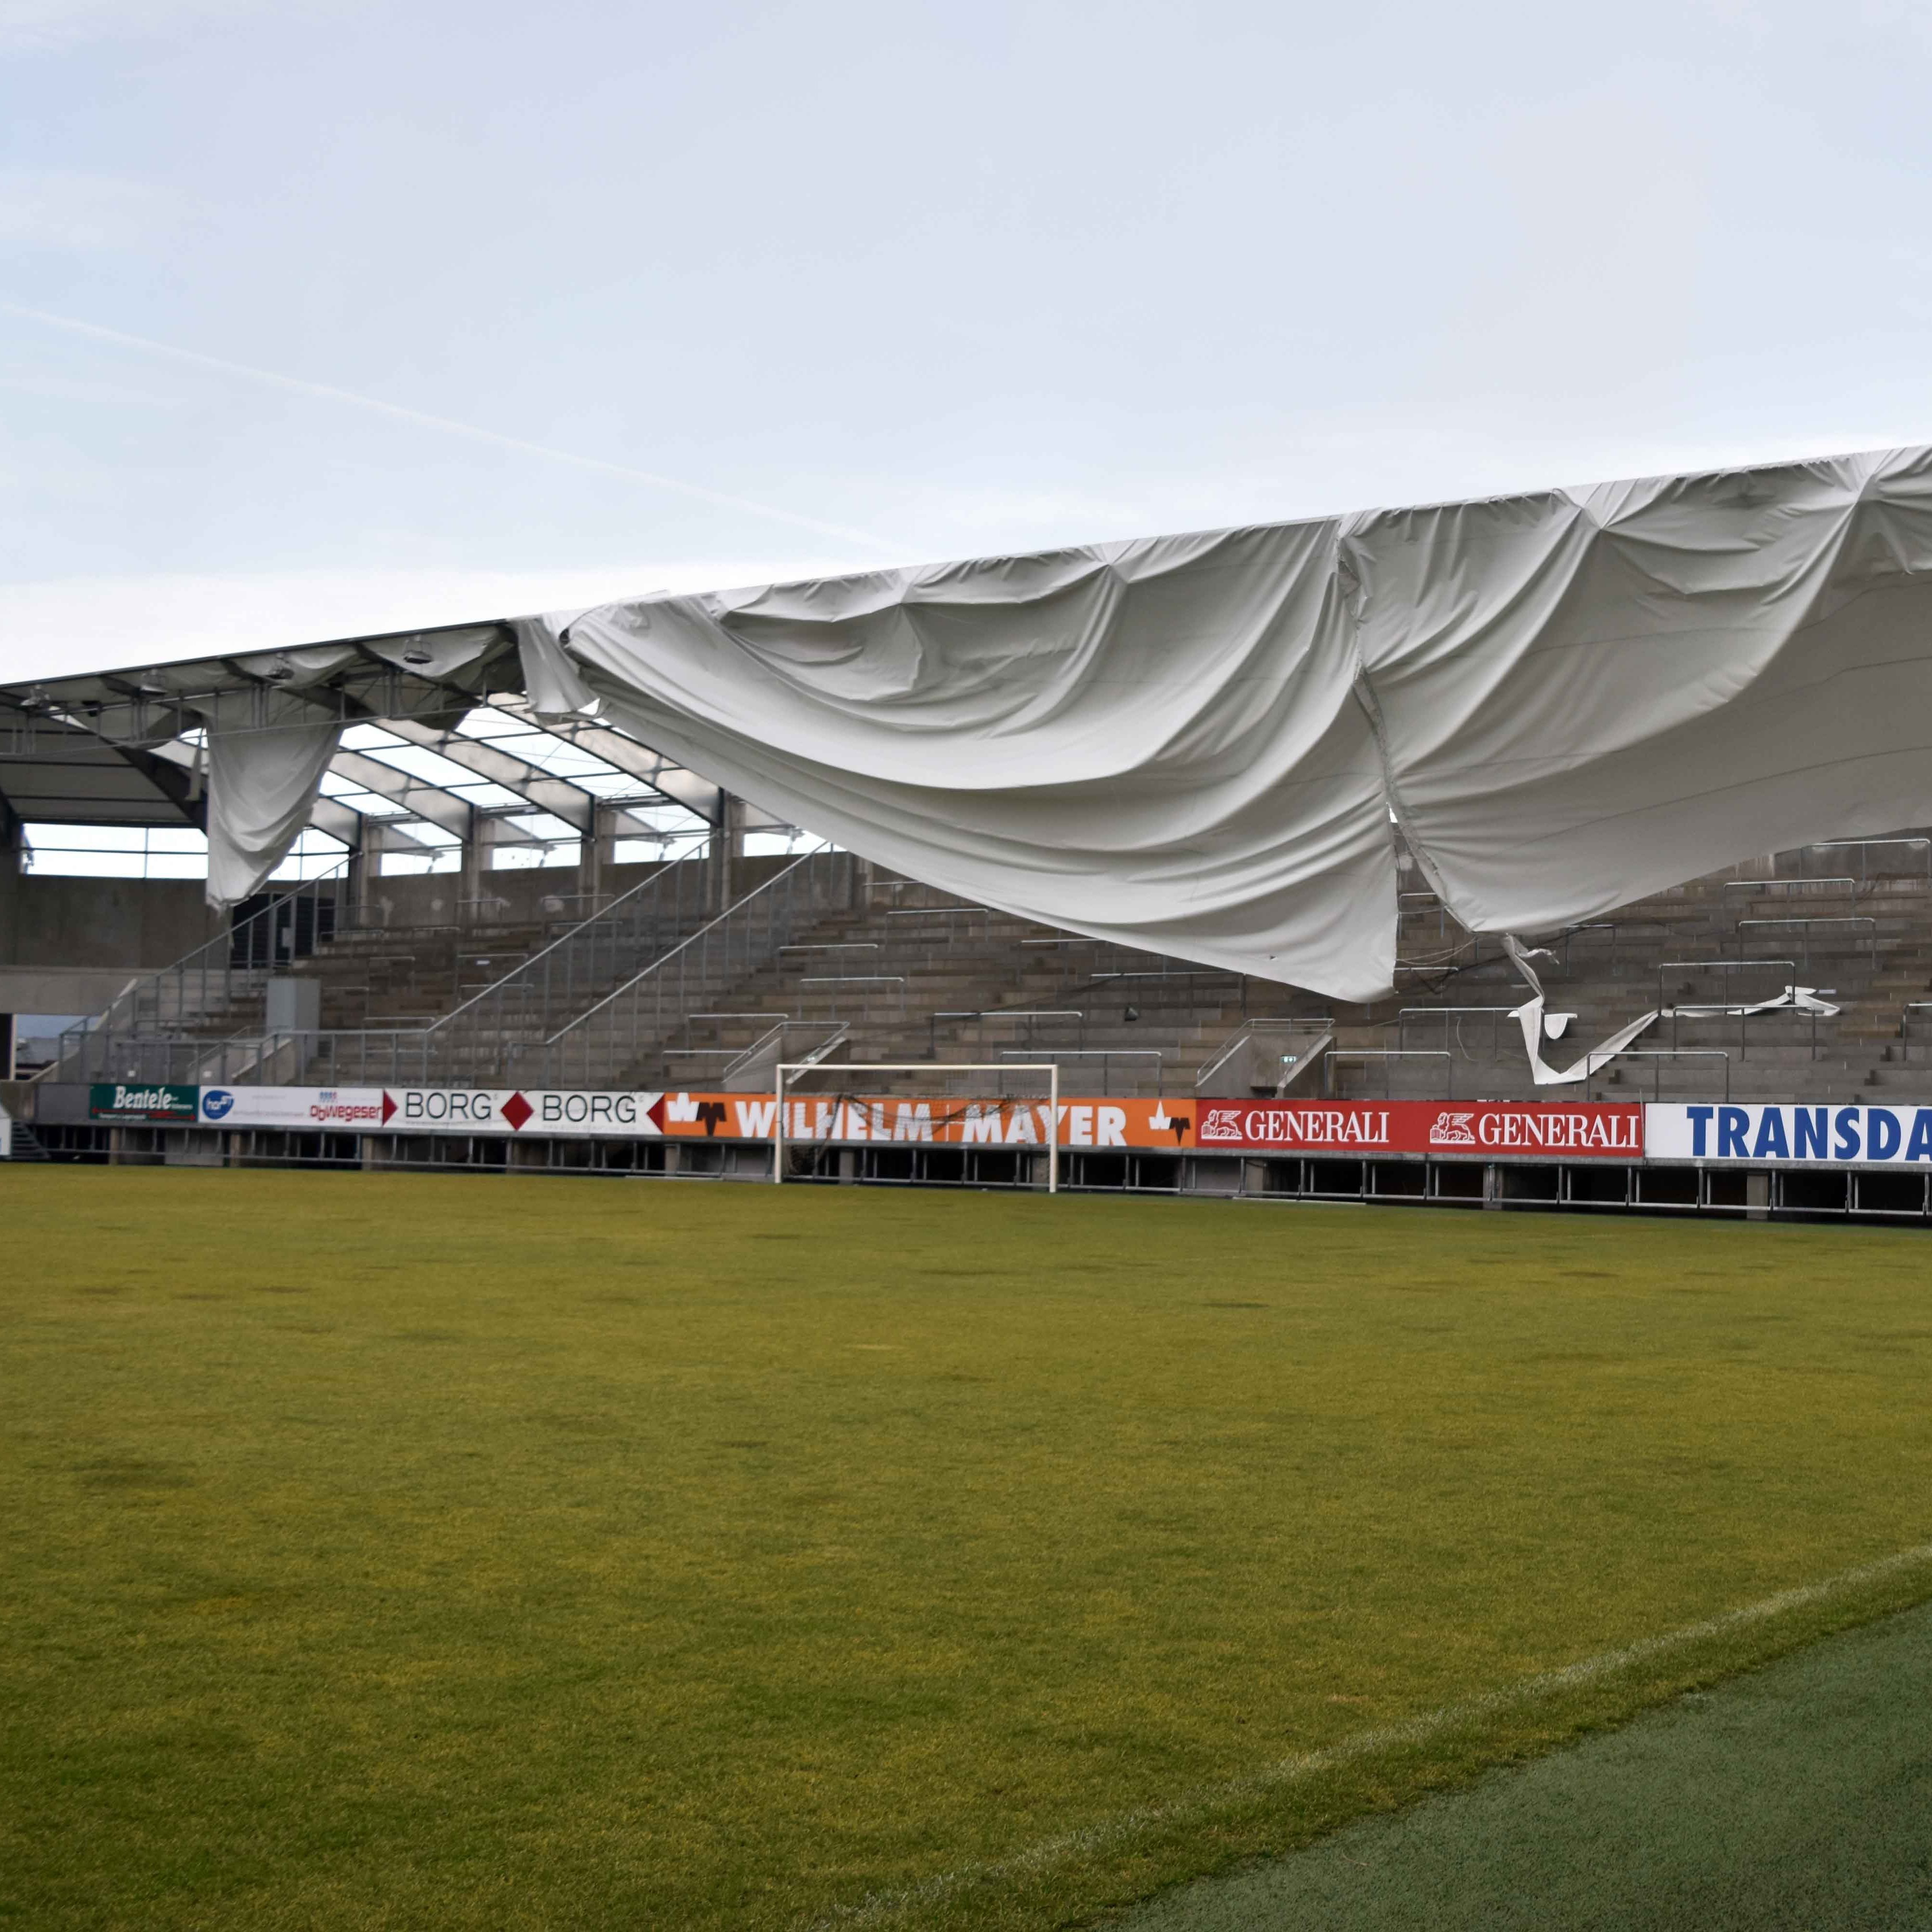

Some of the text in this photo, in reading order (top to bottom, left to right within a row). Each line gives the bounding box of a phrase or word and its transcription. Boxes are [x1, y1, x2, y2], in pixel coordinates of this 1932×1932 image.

[113, 1086, 172, 1109] Bentele
[406, 1092, 491, 1120] BORG
[543, 1094, 636, 1123] BORG
[735, 1100, 1128, 1146] WILHELM MAYER
[1245, 1110, 1390, 1144] GENERALI
[1478, 1113, 1639, 1149] GENERALI
[1687, 1106, 1932, 1161] TRANSDA
